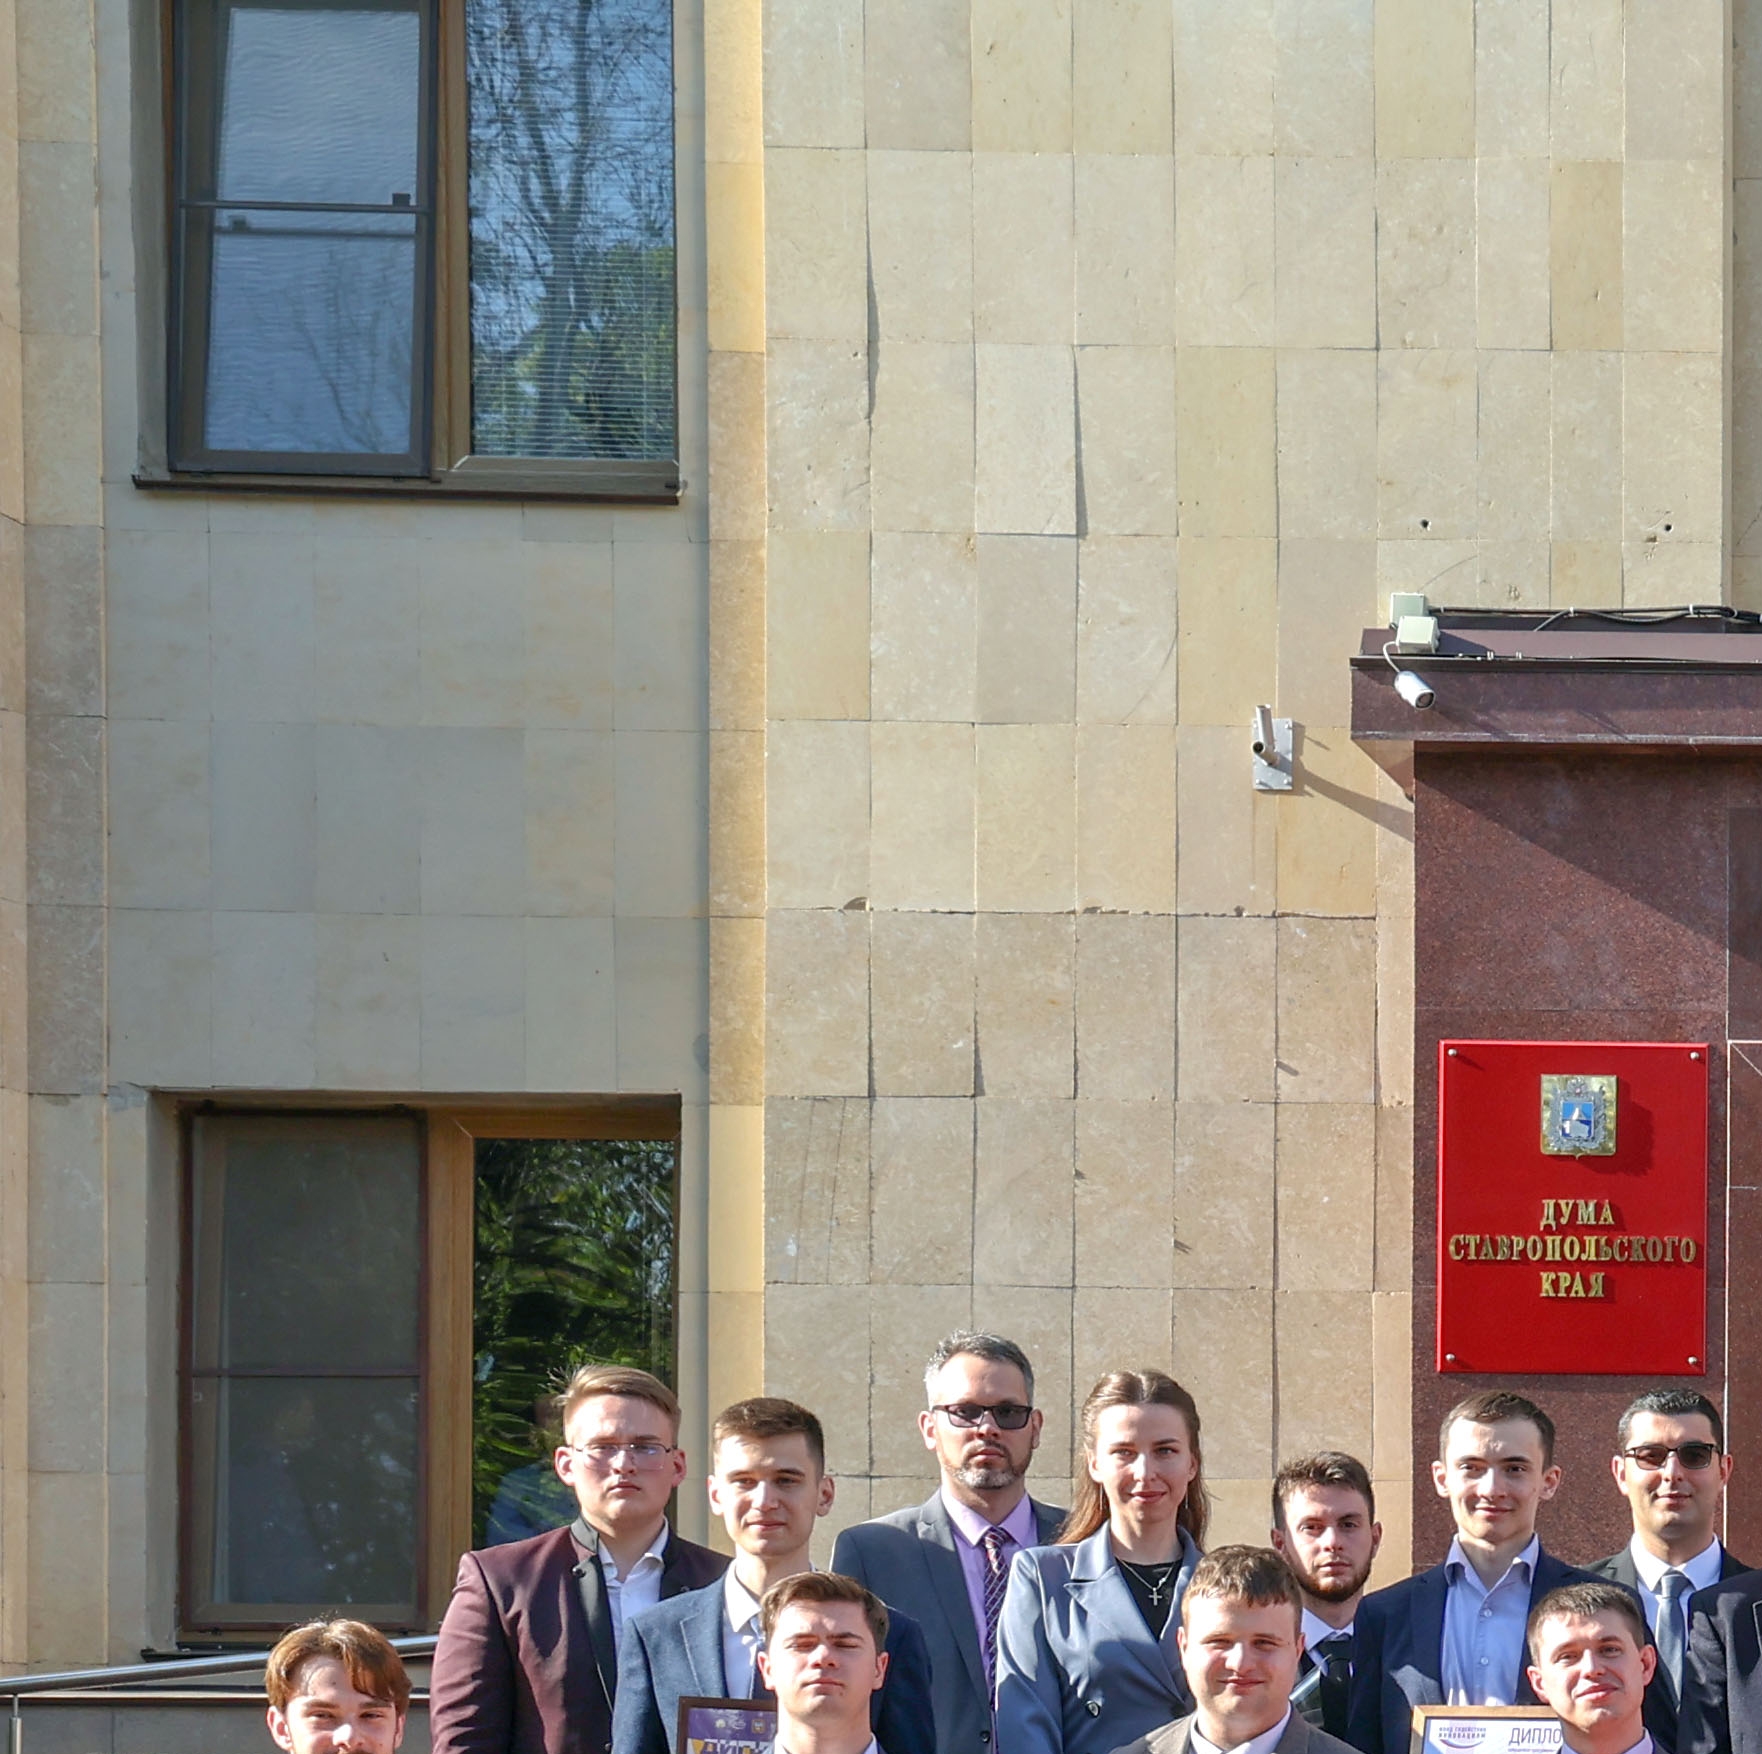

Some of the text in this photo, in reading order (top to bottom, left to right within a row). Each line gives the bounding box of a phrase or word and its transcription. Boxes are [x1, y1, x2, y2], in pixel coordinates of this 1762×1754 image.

[1540, 1199, 1615, 1231] ДУМА
[1449, 1234, 1697, 1263] СТАВРОПОЛЬСКОГО
[1540, 1272, 1605, 1297] КРАЯ
[1508, 1728, 1562, 1746] ДИПЛО
